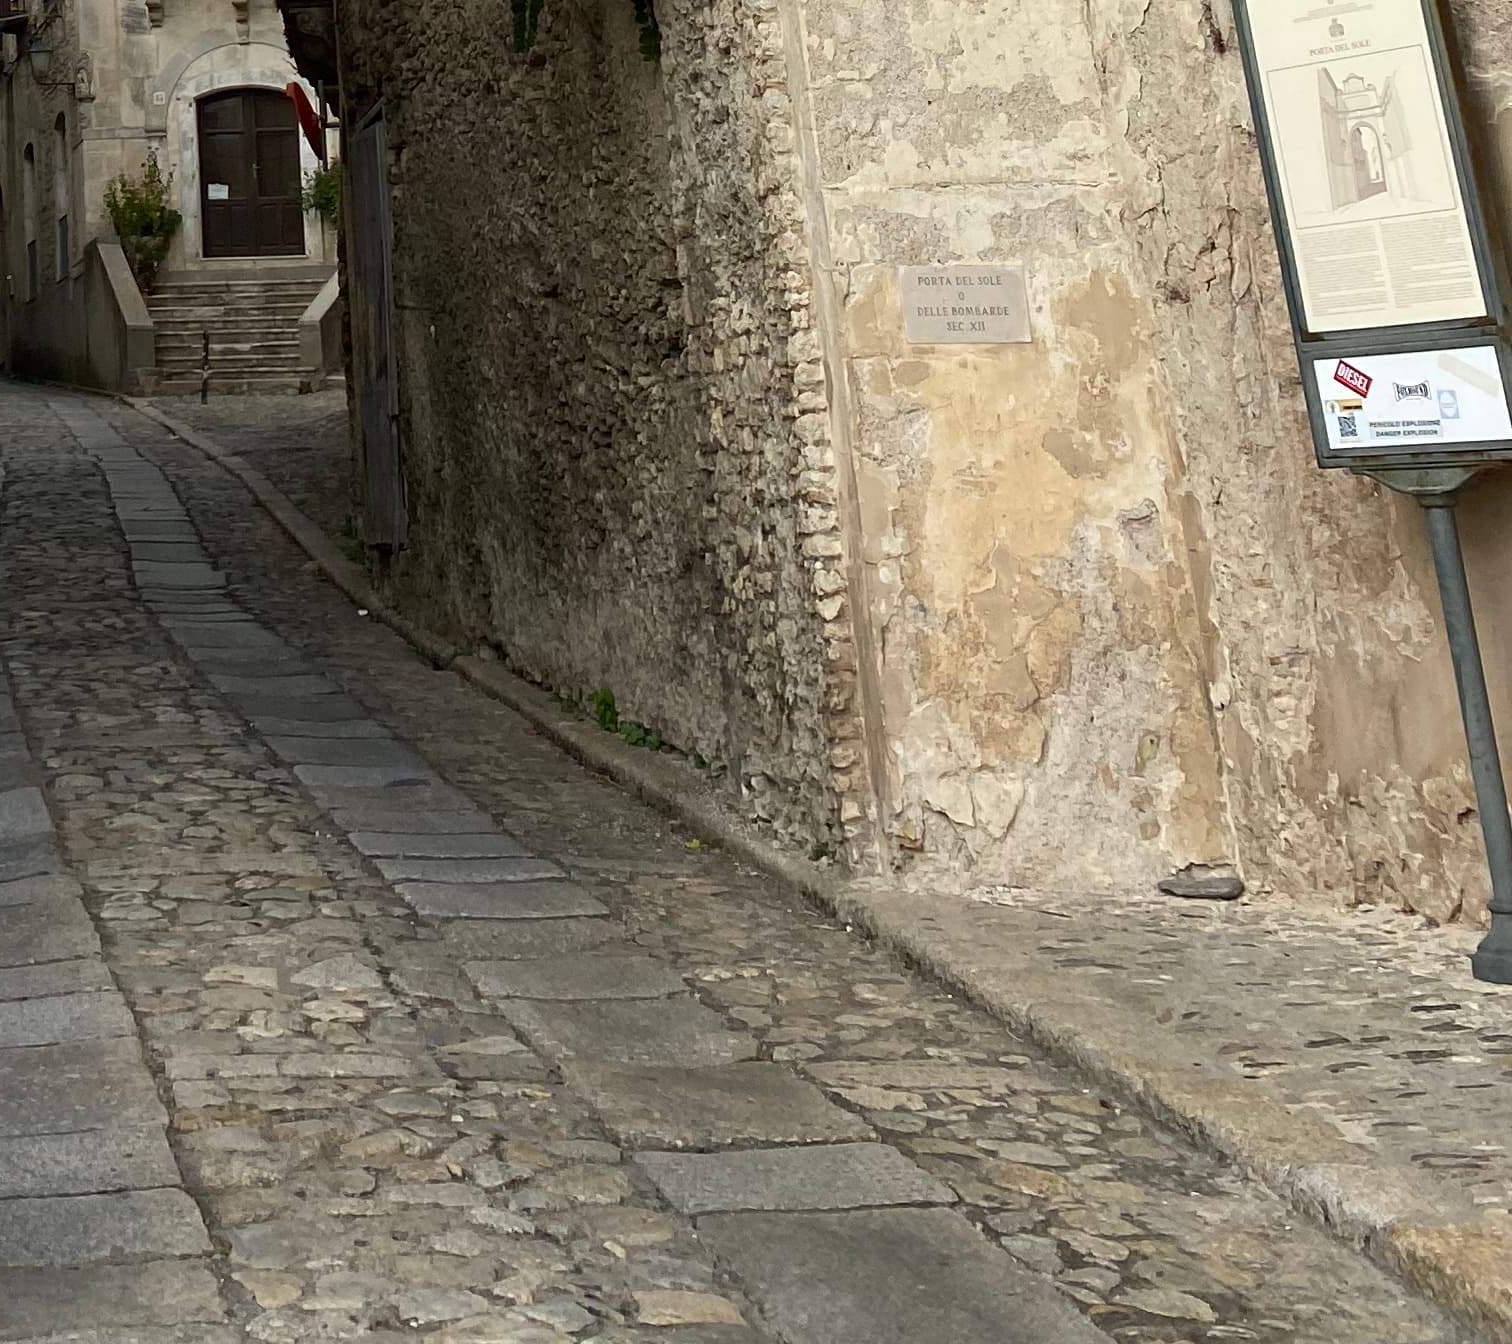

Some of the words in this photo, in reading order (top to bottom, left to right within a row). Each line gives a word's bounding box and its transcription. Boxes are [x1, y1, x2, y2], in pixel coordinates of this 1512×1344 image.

[1310, 47, 1334, 56] PORTA
[1351, 40, 1371, 49] SOLE
[917, 276, 952, 286] PORTA
[955, 275, 975, 286] DEL
[977, 275, 1003, 286] SOLE
[917, 306, 949, 317] DELLE
[951, 306, 1010, 316] BOMBARDE
[1337, 362, 1368, 394] DIESEL
